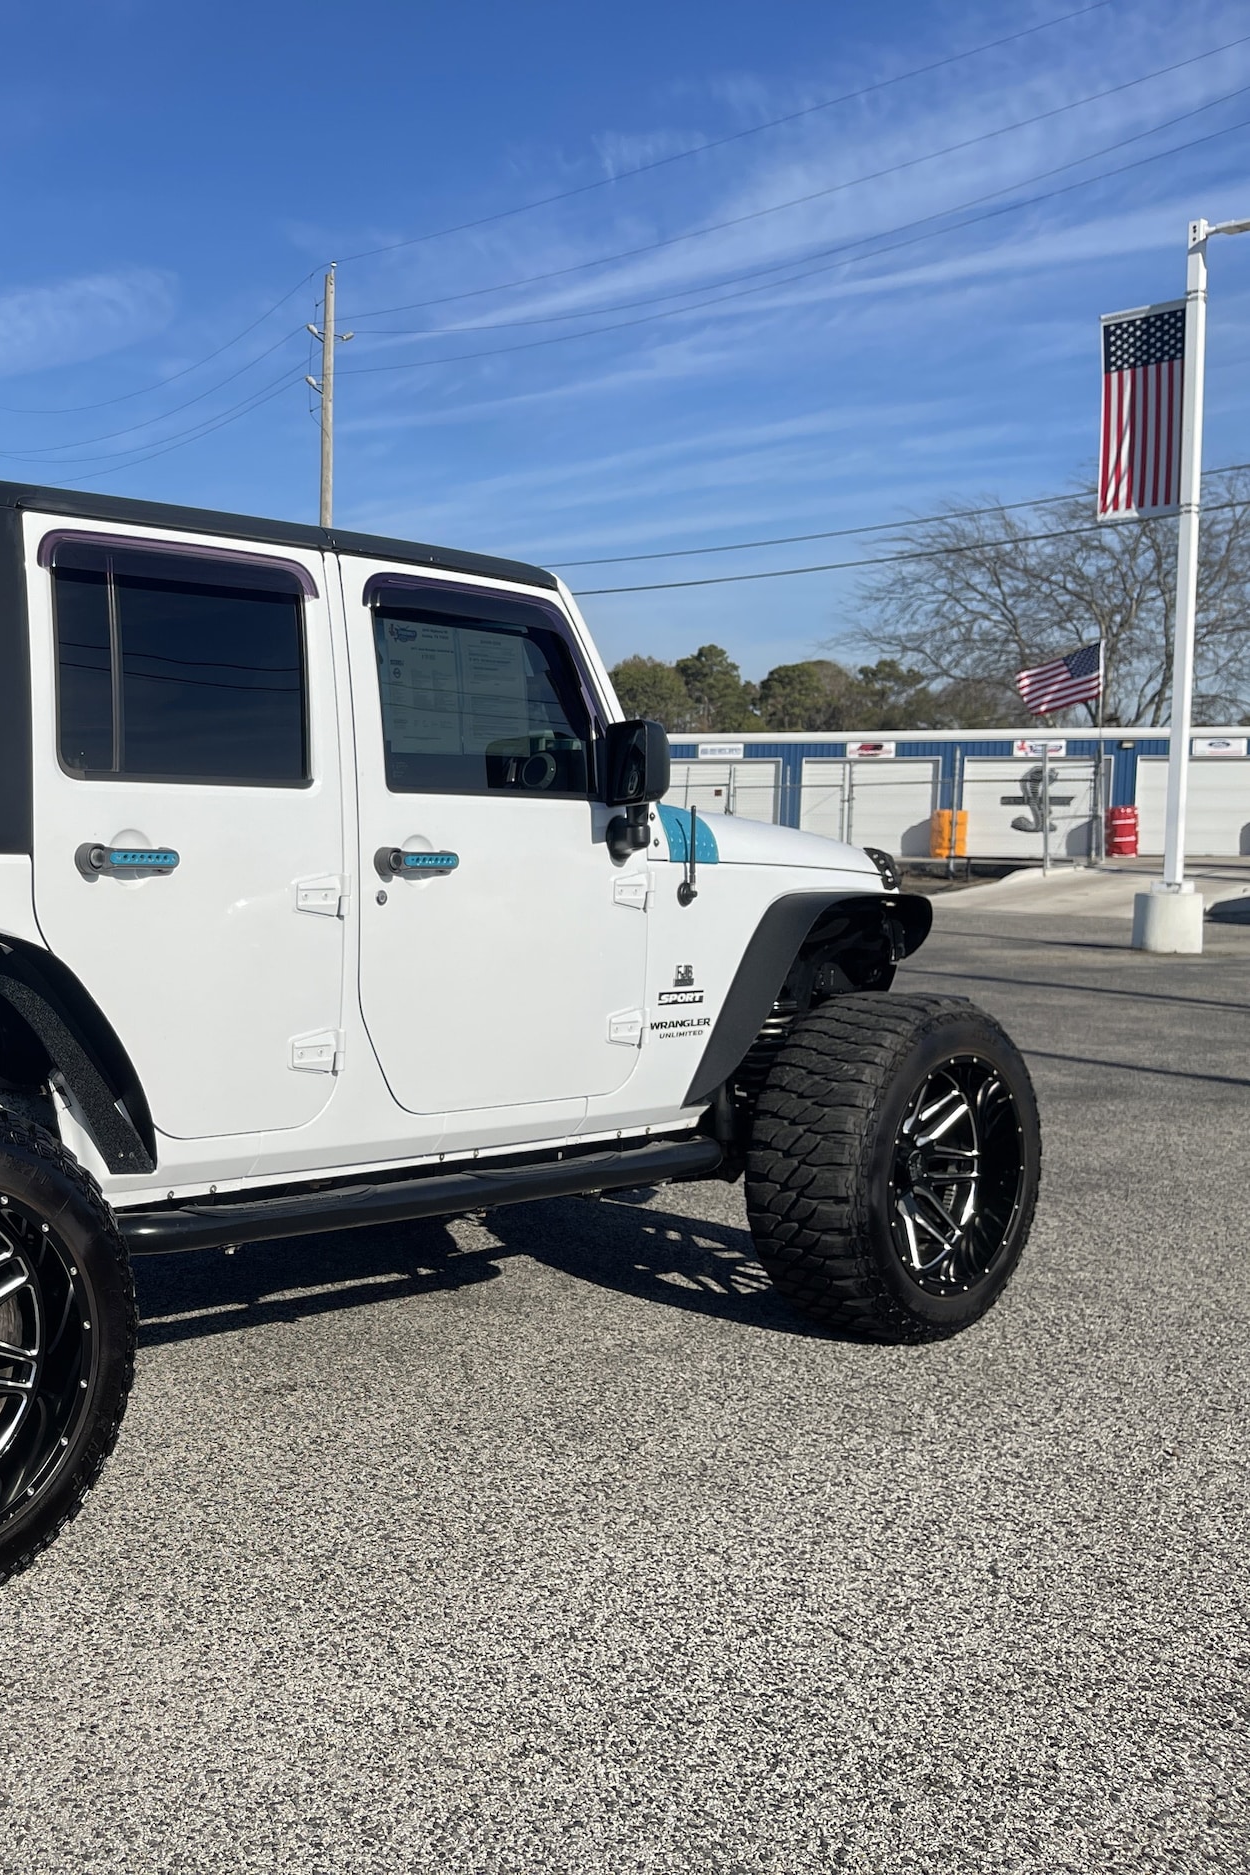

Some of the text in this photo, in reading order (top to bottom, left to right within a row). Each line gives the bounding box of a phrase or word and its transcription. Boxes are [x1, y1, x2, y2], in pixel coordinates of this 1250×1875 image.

[659, 993, 703, 1003] SPORT
[650, 1018, 711, 1030] WRANGLER
[659, 1030, 704, 1039] UNLIMITED
